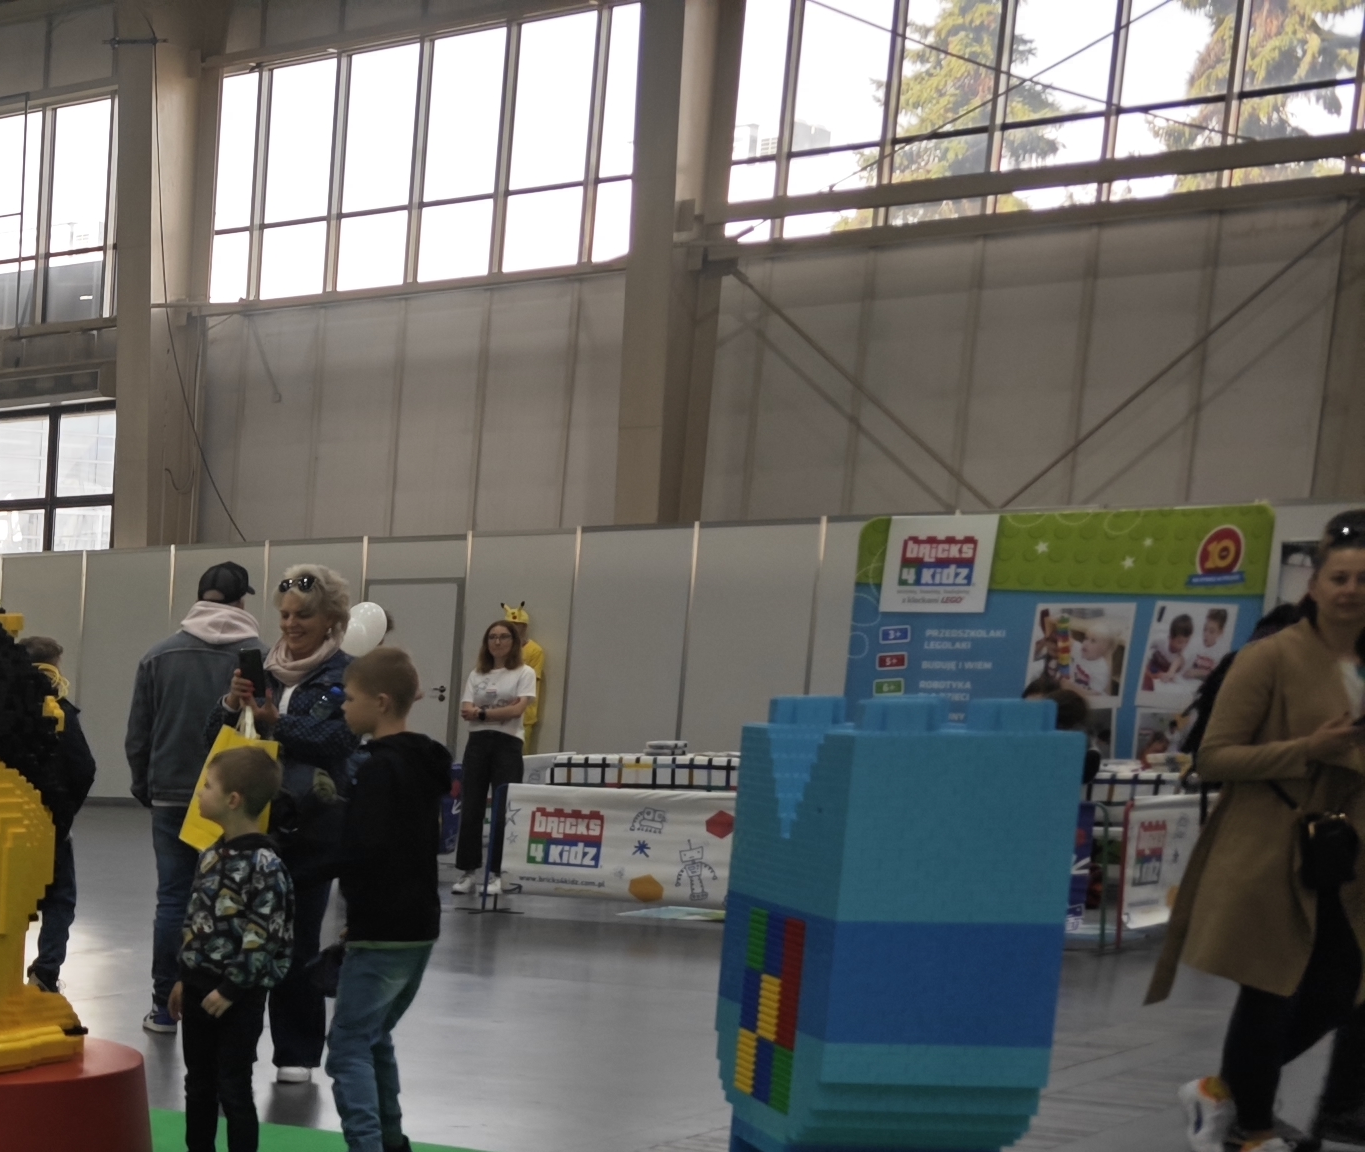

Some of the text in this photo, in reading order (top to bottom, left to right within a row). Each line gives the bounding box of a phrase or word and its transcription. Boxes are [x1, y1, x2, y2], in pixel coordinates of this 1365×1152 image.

[1204, 539, 1236, 569] 10
[901, 567, 916, 584] 4
[888, 629, 902, 640] 3+
[925, 629, 1006, 638] PRZEDSZKOLAKI
[885, 657, 898, 667] 5+
[964, 661, 993, 669] WIEM
[882, 683, 896, 692] 6+
[918, 680, 972, 689] ROBOTYKA
[529, 843, 545, 862] 4
